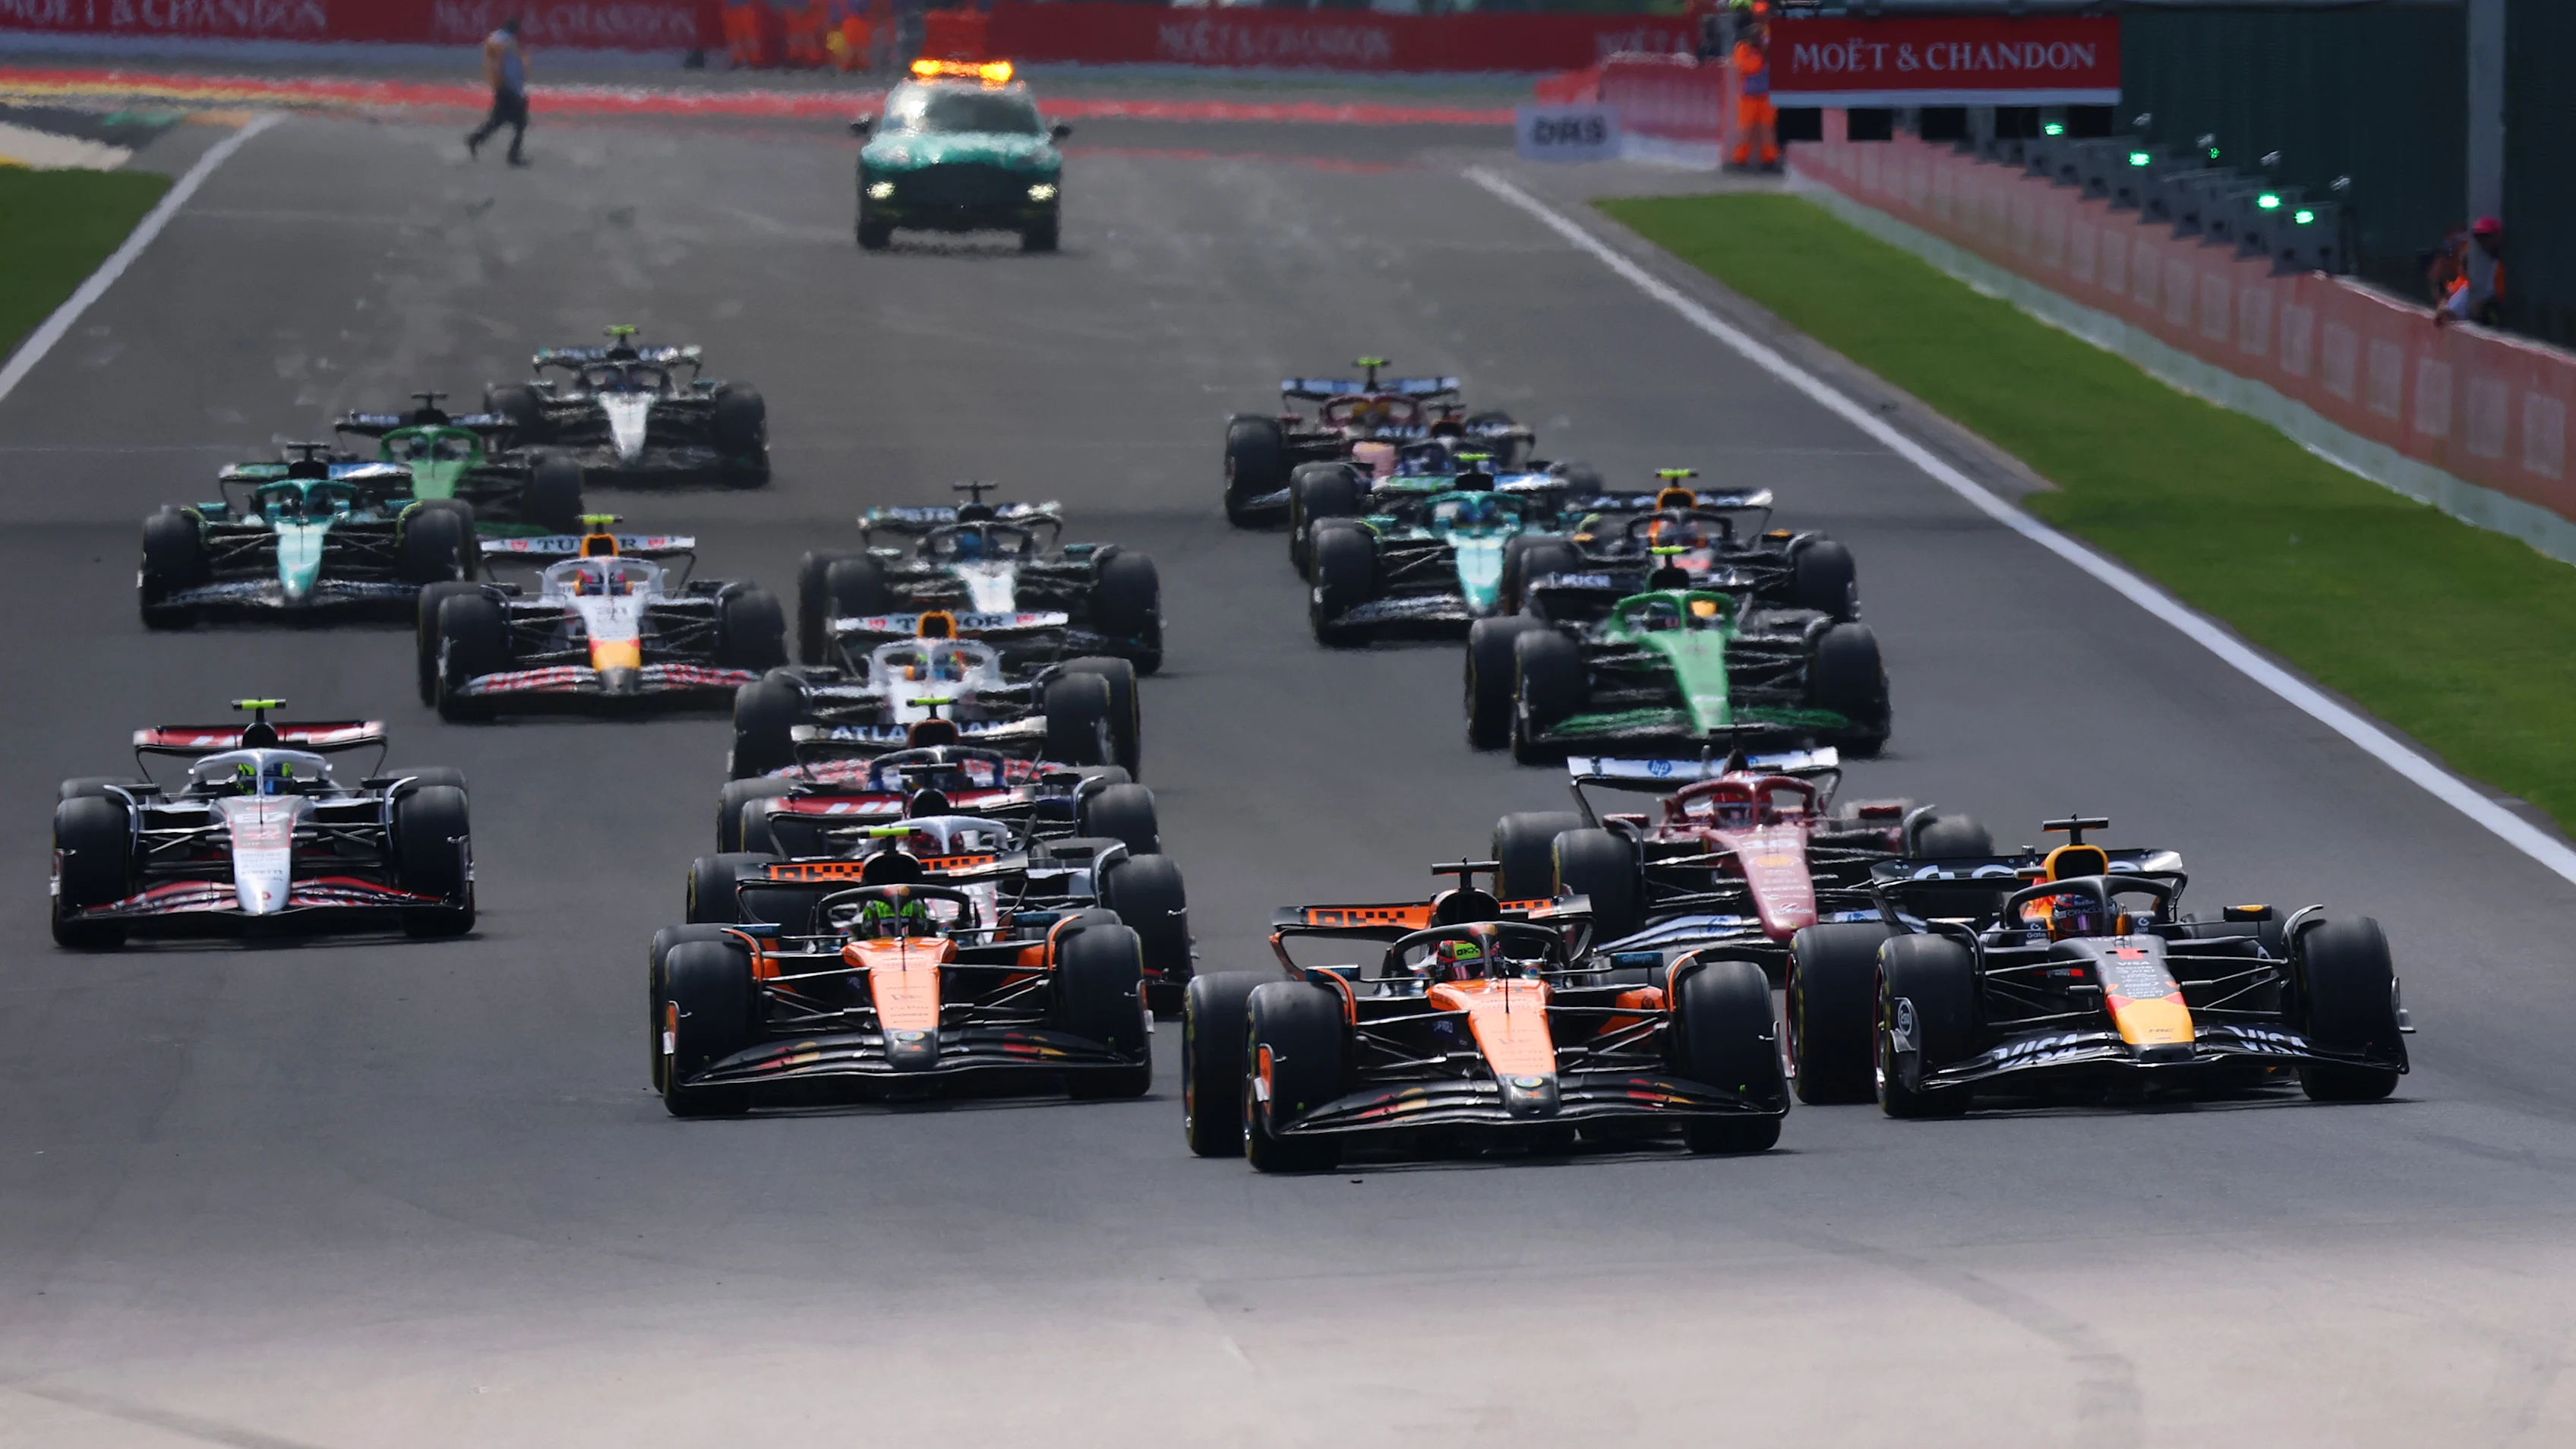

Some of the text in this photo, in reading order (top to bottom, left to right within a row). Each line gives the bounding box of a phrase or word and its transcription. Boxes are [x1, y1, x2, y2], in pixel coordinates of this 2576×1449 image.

[1792, 38, 2096, 72] MOËT & CHANDON
